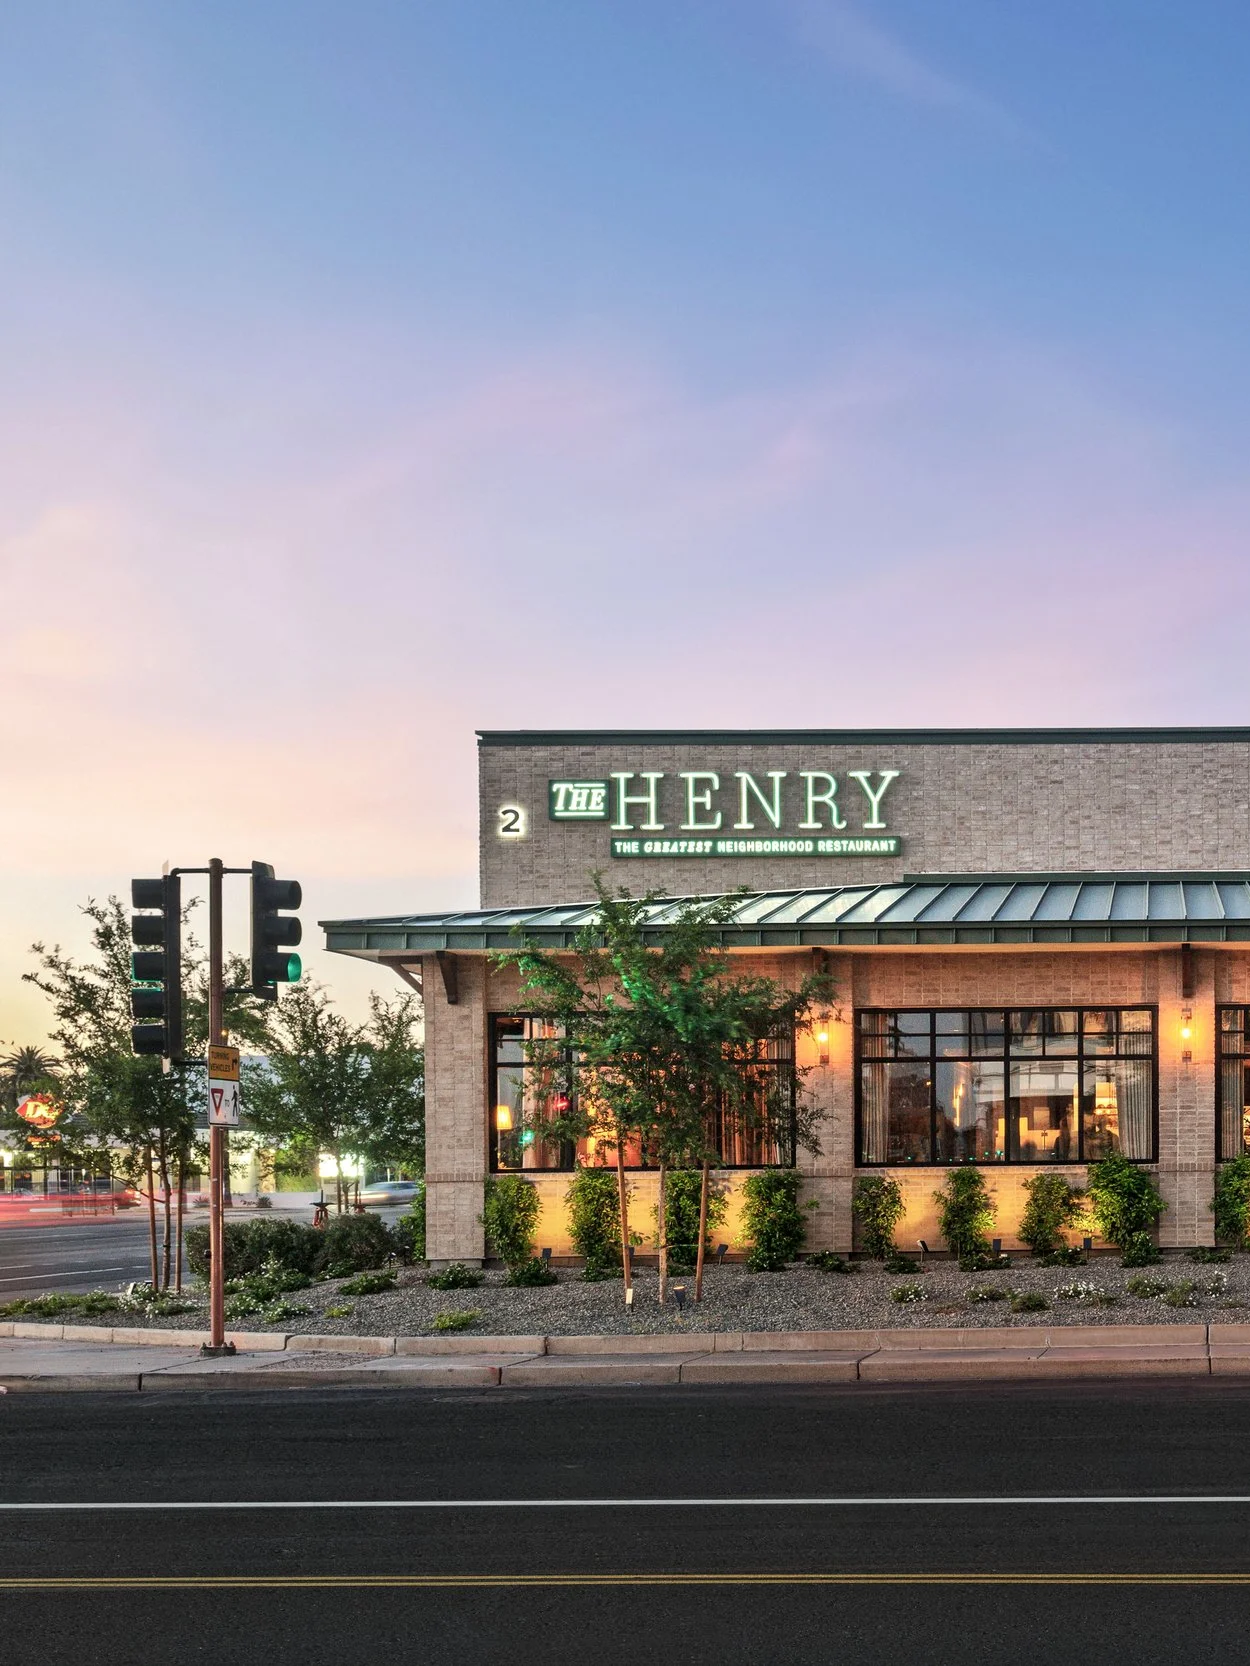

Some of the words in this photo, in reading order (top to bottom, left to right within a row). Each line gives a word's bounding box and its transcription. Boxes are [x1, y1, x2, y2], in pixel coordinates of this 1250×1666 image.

[552, 783, 606, 811] THE
[610, 770, 900, 831] HENRY
[501, 809, 520, 833] 2
[615, 841, 639, 854] THE
[644, 841, 713, 854] GREATEST
[718, 840, 813, 853] NEIGHBORHOOD
[818, 839, 896, 852] RESTAURANT
[210, 1063, 232, 1072] VEHICLES
